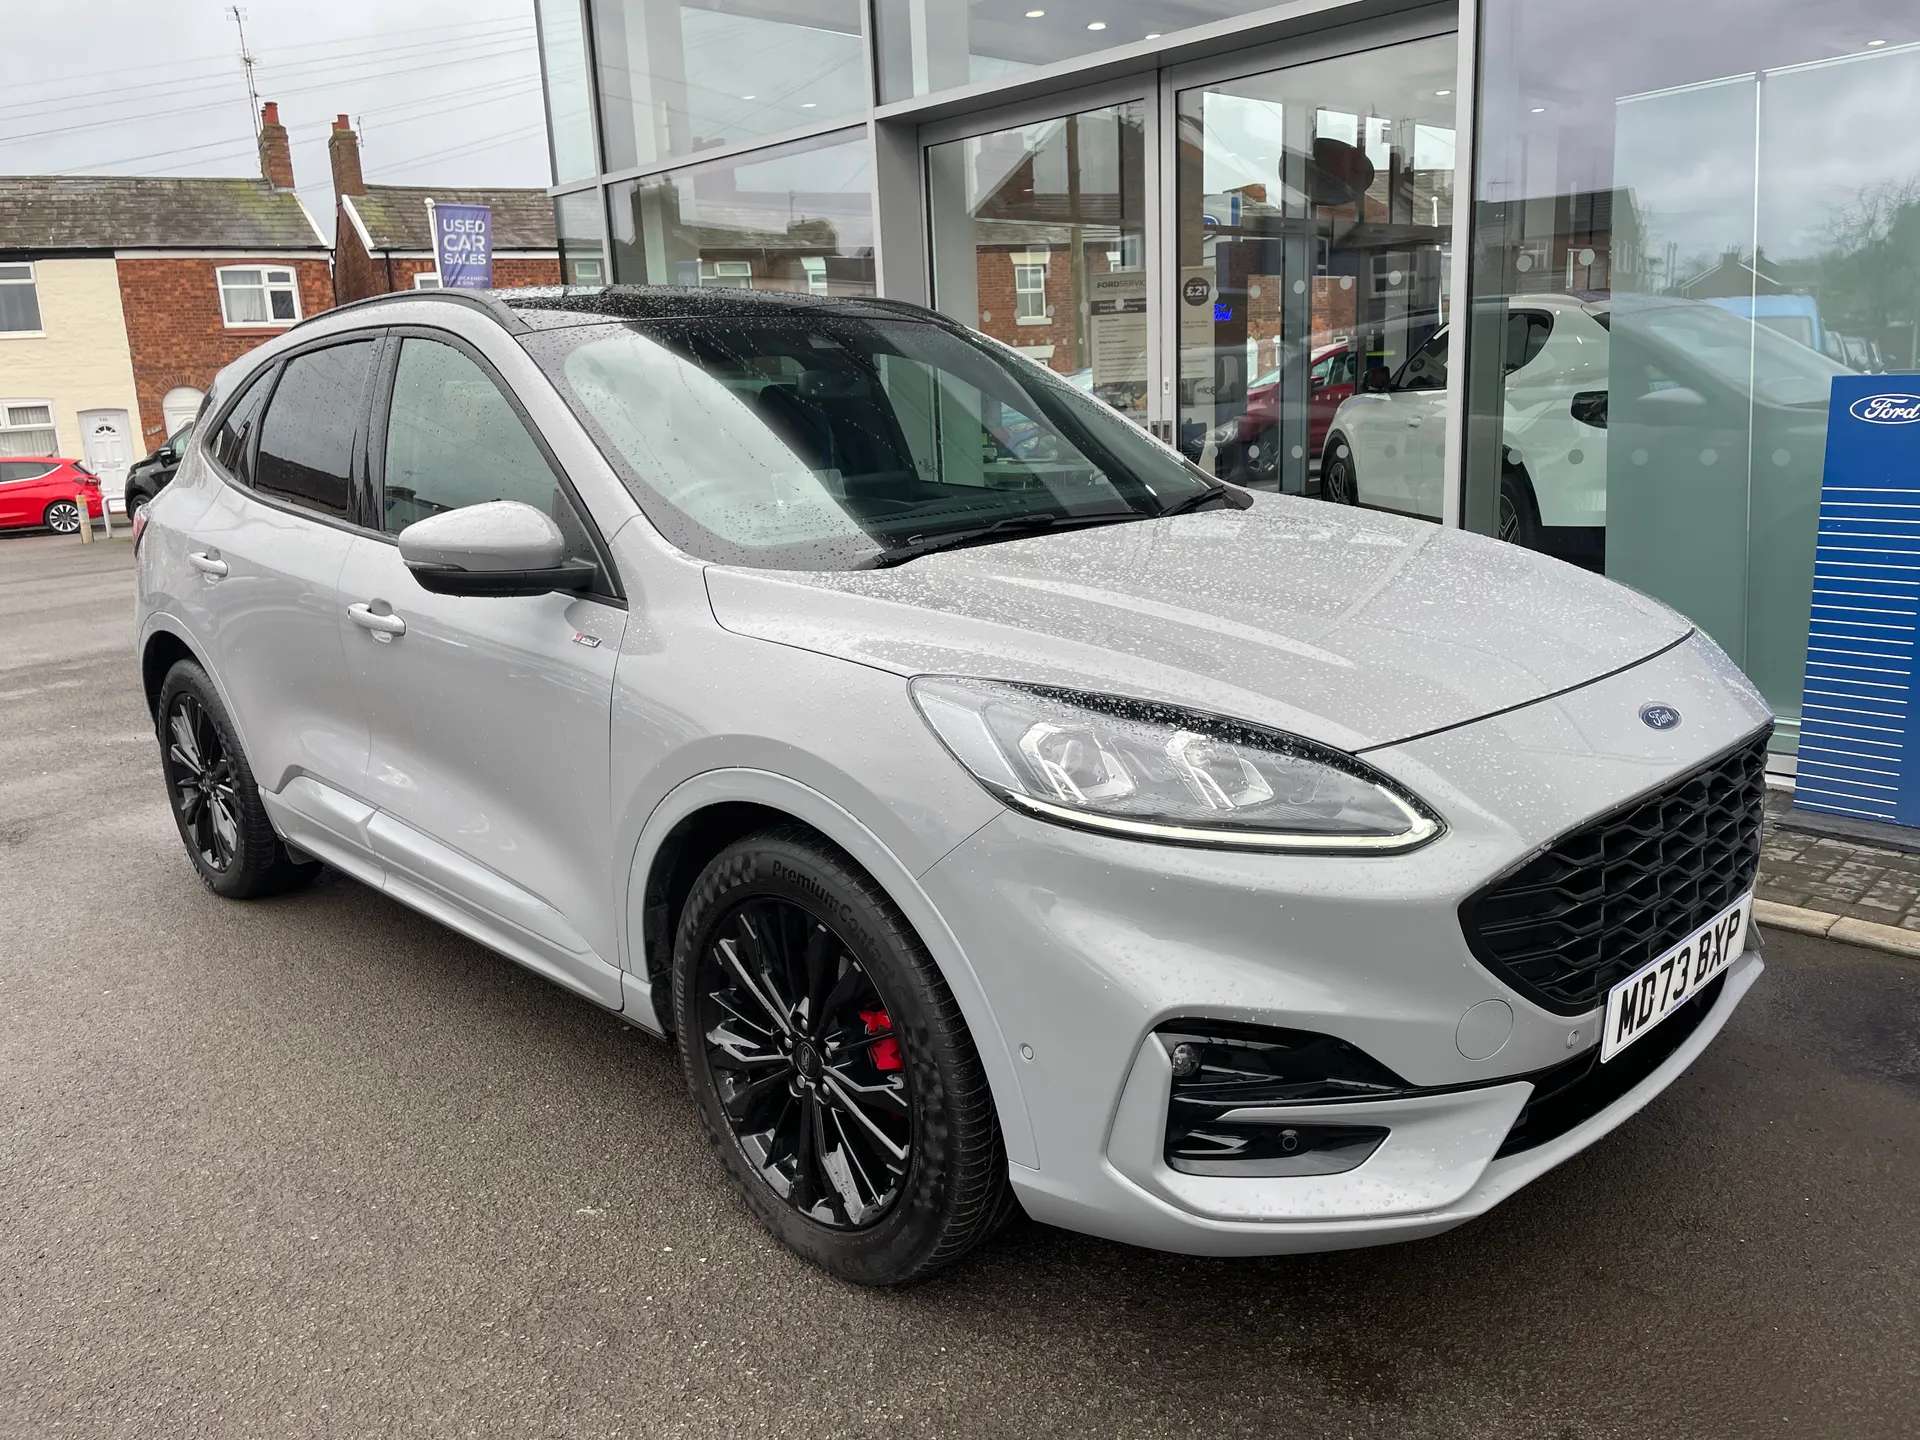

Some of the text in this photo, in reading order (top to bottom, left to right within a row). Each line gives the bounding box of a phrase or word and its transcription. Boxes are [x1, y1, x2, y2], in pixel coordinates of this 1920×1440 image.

[443, 219, 485, 233] USED
[443, 234, 485, 251] CAR
[444, 253, 487, 264] SALES
[1864, 398, 1920, 419] Ford
[1648, 709, 1674, 727] Ford
[1616, 909, 1741, 1044] MD73 BXP
